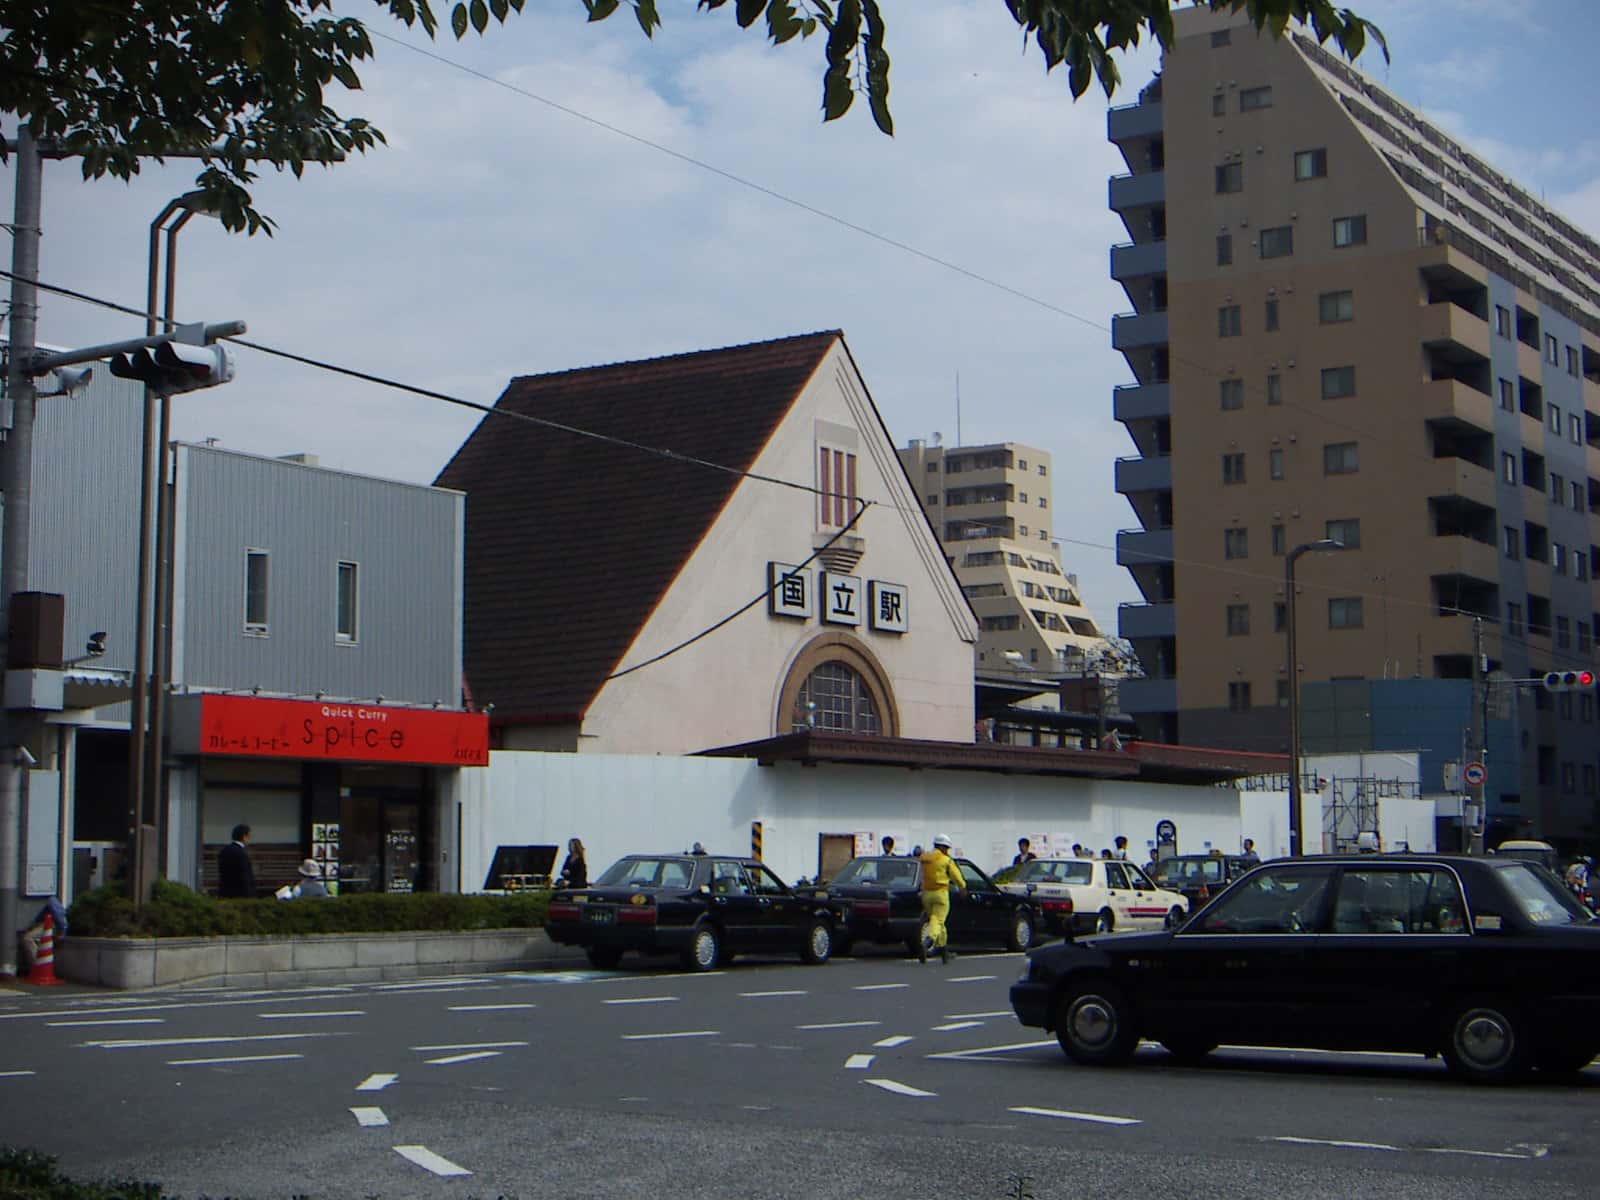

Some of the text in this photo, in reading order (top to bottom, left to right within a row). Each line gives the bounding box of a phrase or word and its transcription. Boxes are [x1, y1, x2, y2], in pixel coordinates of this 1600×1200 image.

[782, 572, 901, 624] 国立駅
[321, 706, 388, 722] Quick Curry
[302, 718, 406, 753] Spice
